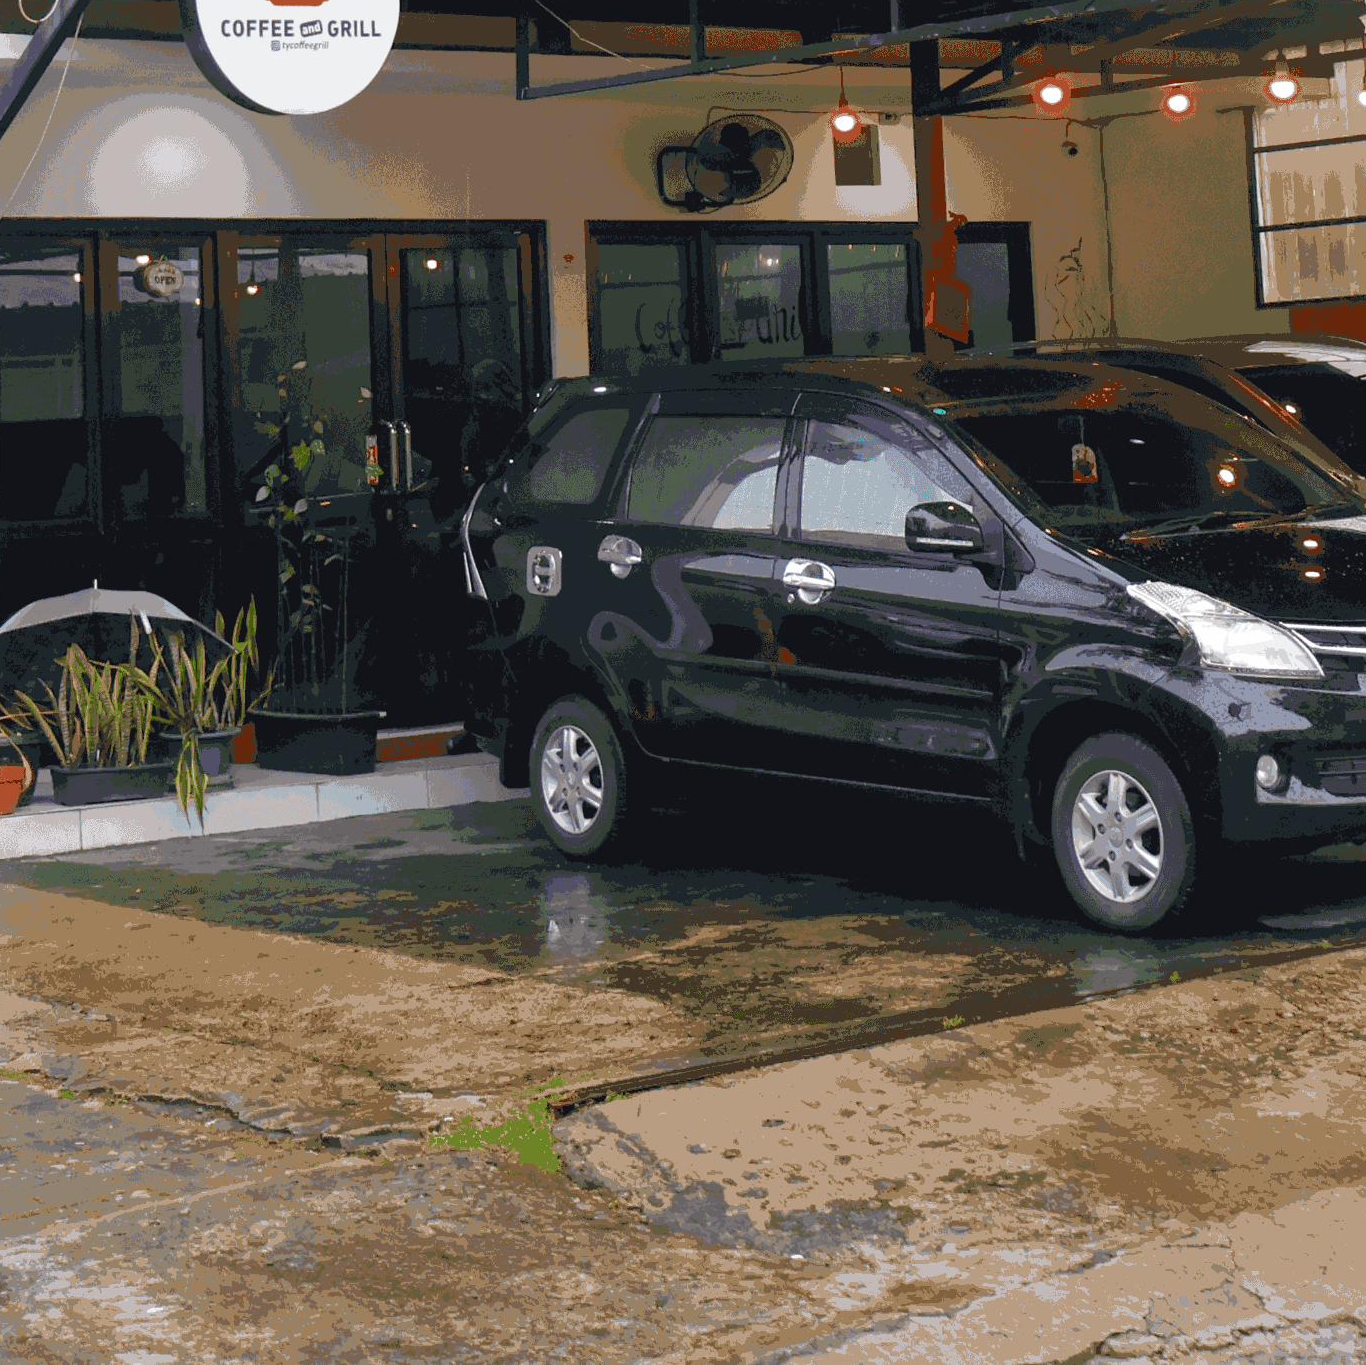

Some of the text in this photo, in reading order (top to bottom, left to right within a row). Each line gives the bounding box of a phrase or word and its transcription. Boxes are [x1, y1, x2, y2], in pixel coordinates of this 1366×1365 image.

[221, 19, 382, 38] COFFEE and GRILL
[282, 40, 329, 52] tycoffeegrill
[154, 276, 177, 285] OPEN
